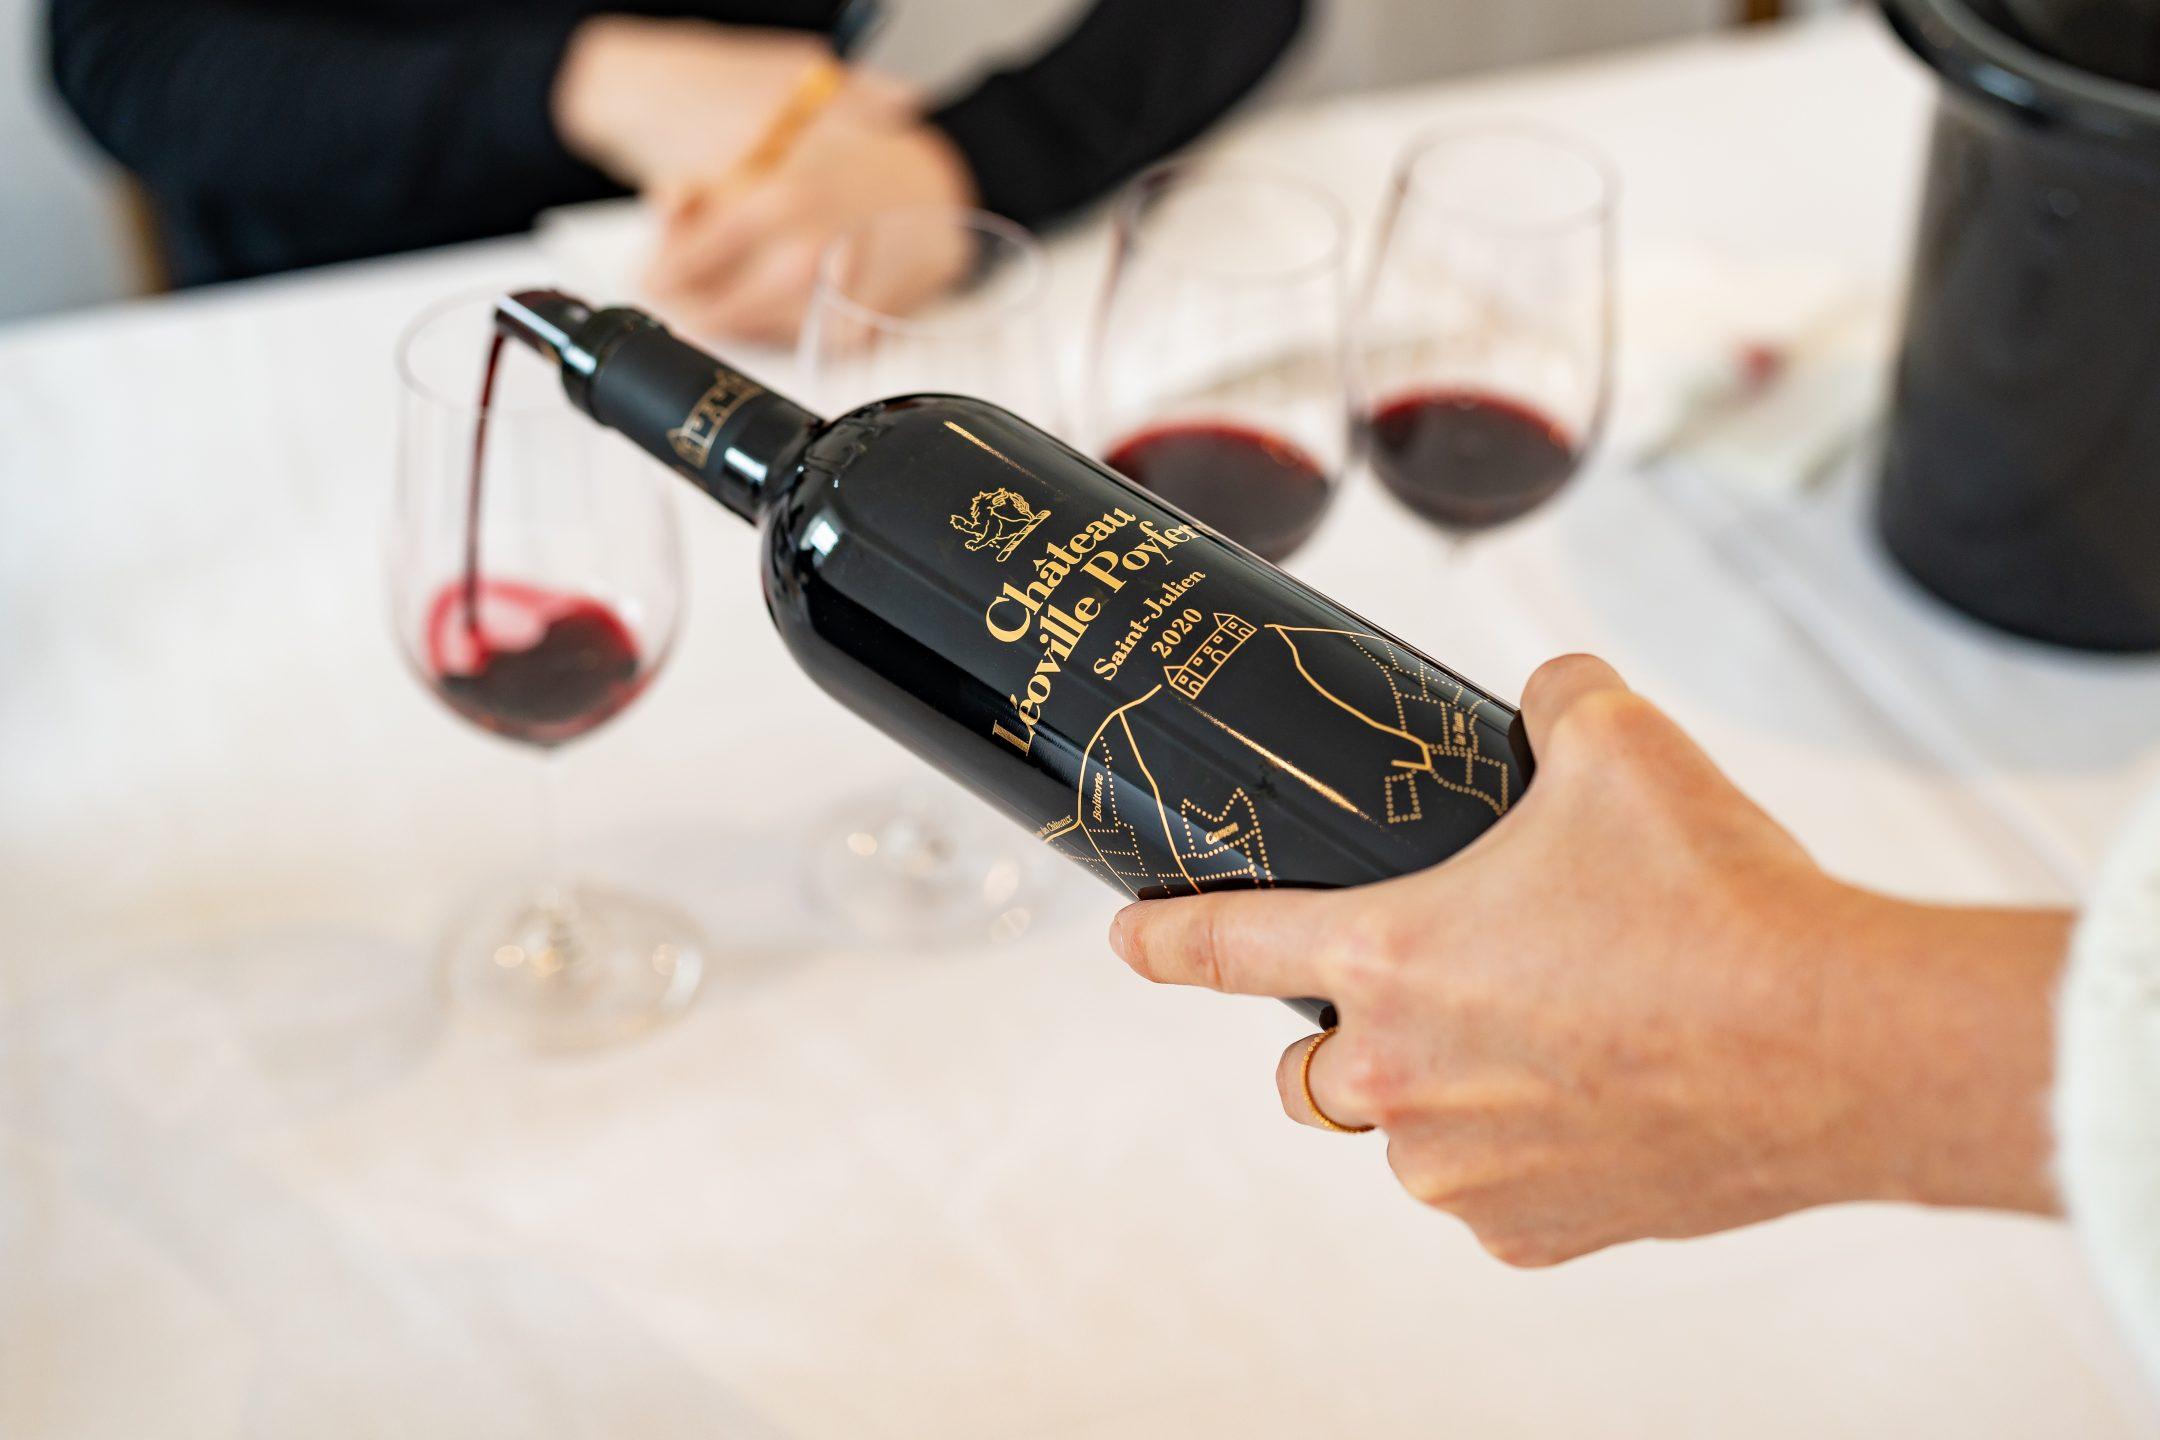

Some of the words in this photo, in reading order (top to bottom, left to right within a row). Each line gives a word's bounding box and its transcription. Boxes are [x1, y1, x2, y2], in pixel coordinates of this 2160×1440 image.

[985, 506, 1136, 642] Château
[1093, 570, 1206, 681] Saint-Julien
[1151, 607, 1203, 659] 2020
[992, 597, 1101, 756] Léoville
